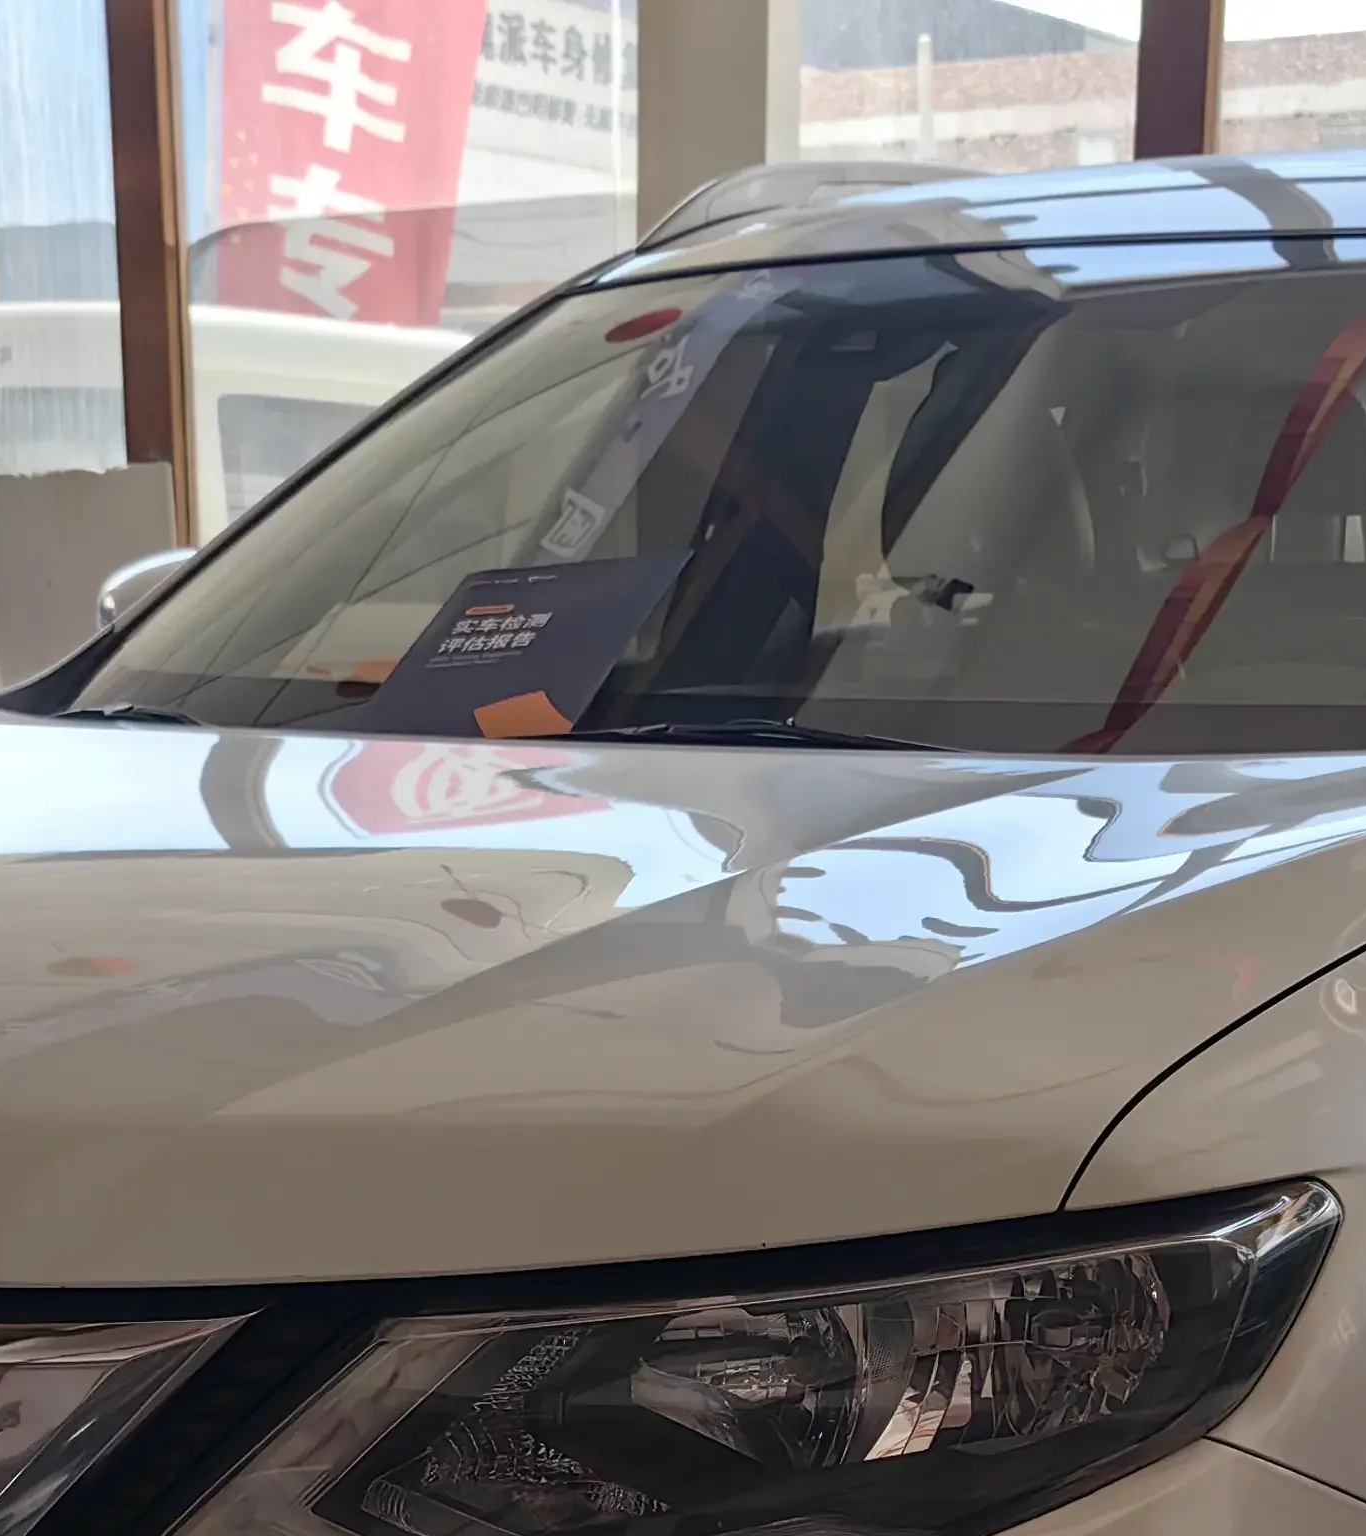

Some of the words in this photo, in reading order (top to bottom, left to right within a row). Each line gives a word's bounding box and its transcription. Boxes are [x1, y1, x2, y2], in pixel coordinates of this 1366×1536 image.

[451, 612, 553, 635] 实车检测
[437, 631, 537, 655] 评估报告
